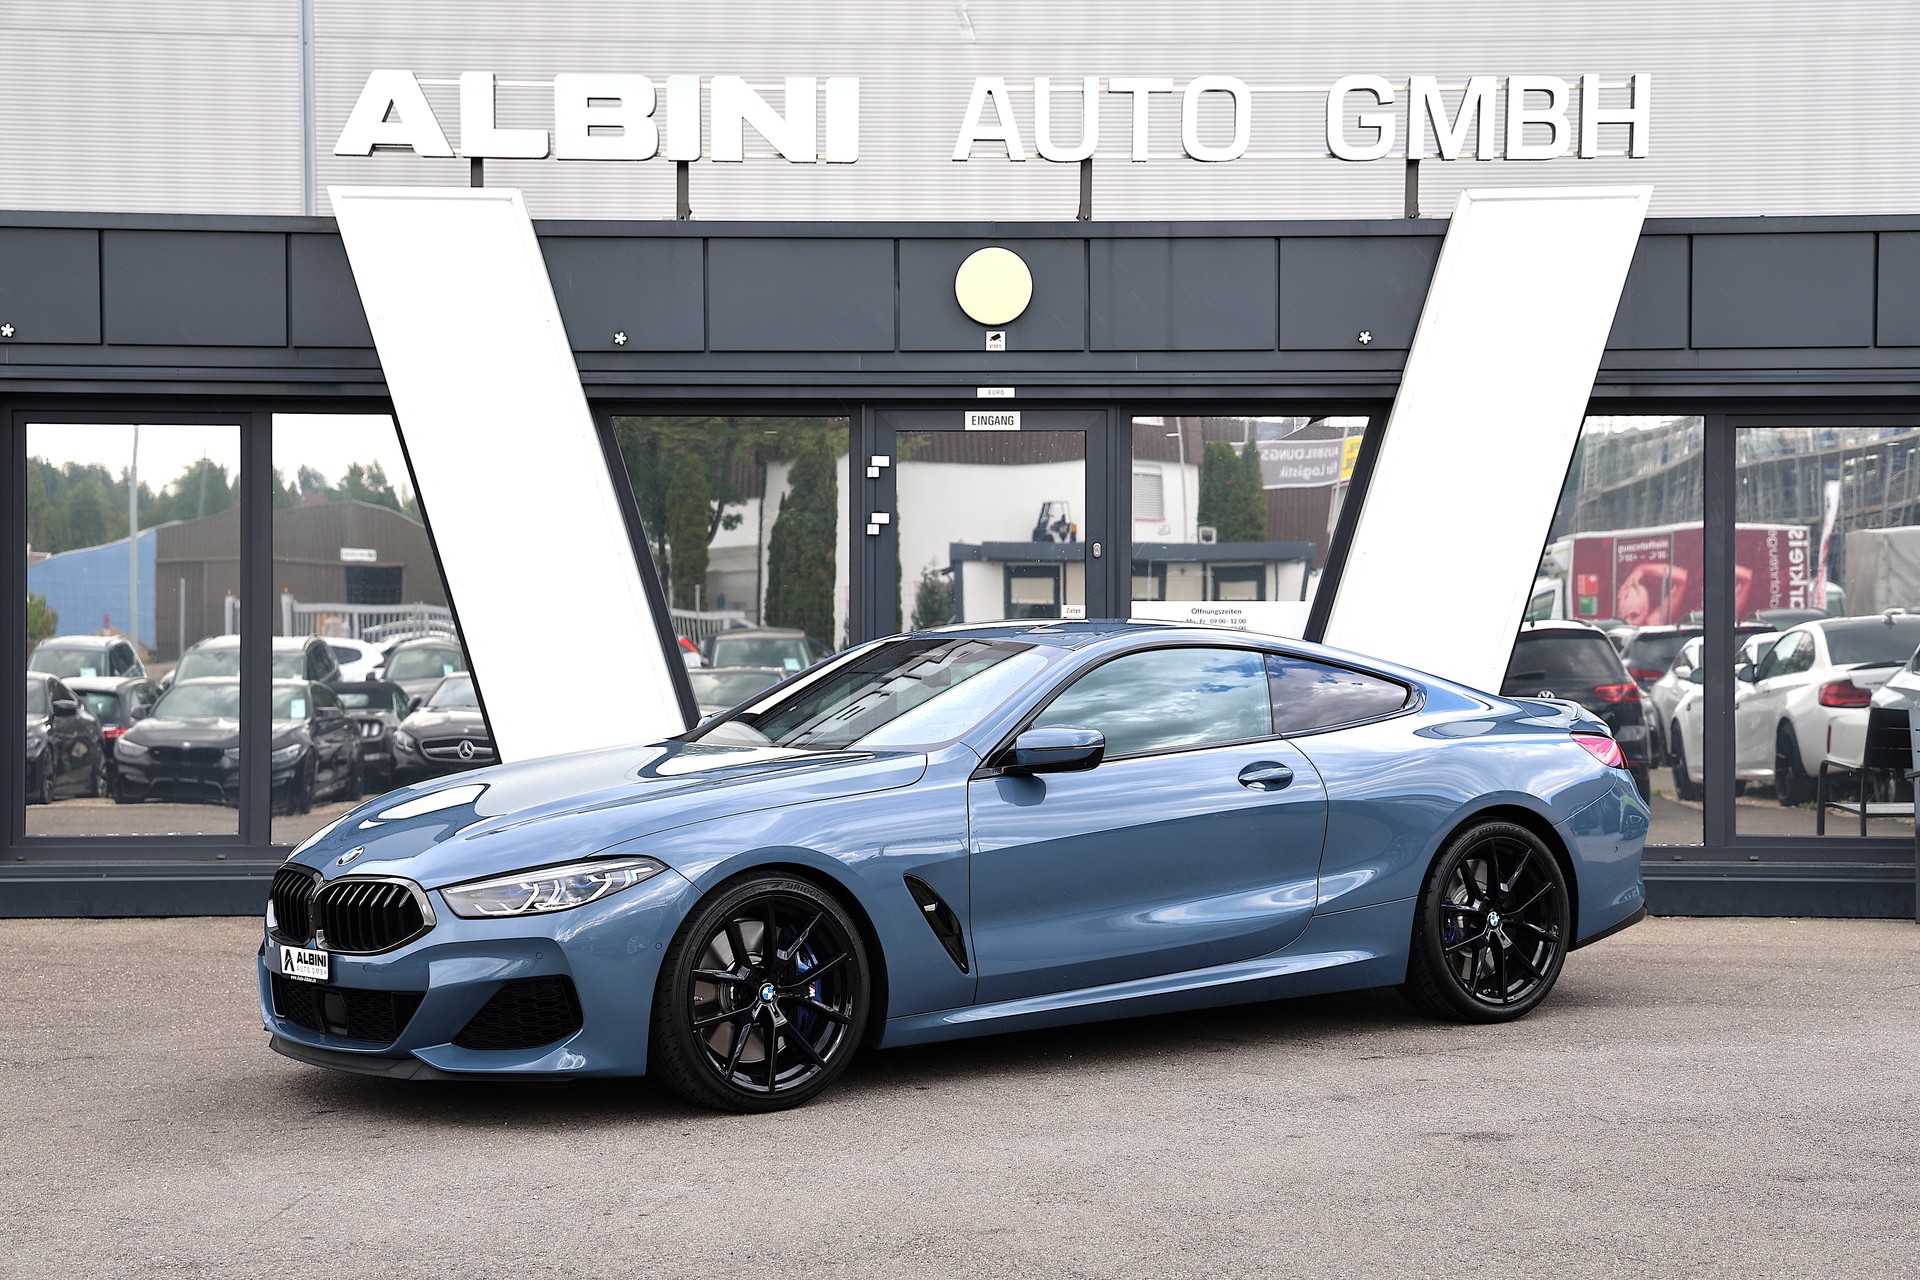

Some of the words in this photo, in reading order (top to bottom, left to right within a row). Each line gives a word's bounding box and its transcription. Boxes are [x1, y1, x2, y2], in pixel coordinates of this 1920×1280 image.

[333, 69, 860, 164] ALBINI
[952, 75, 1252, 162] AUTO
[1325, 73, 1652, 161] GMBH
[971, 415, 1014, 426] EINGANG
[297, 951, 327, 967] ALBINI
